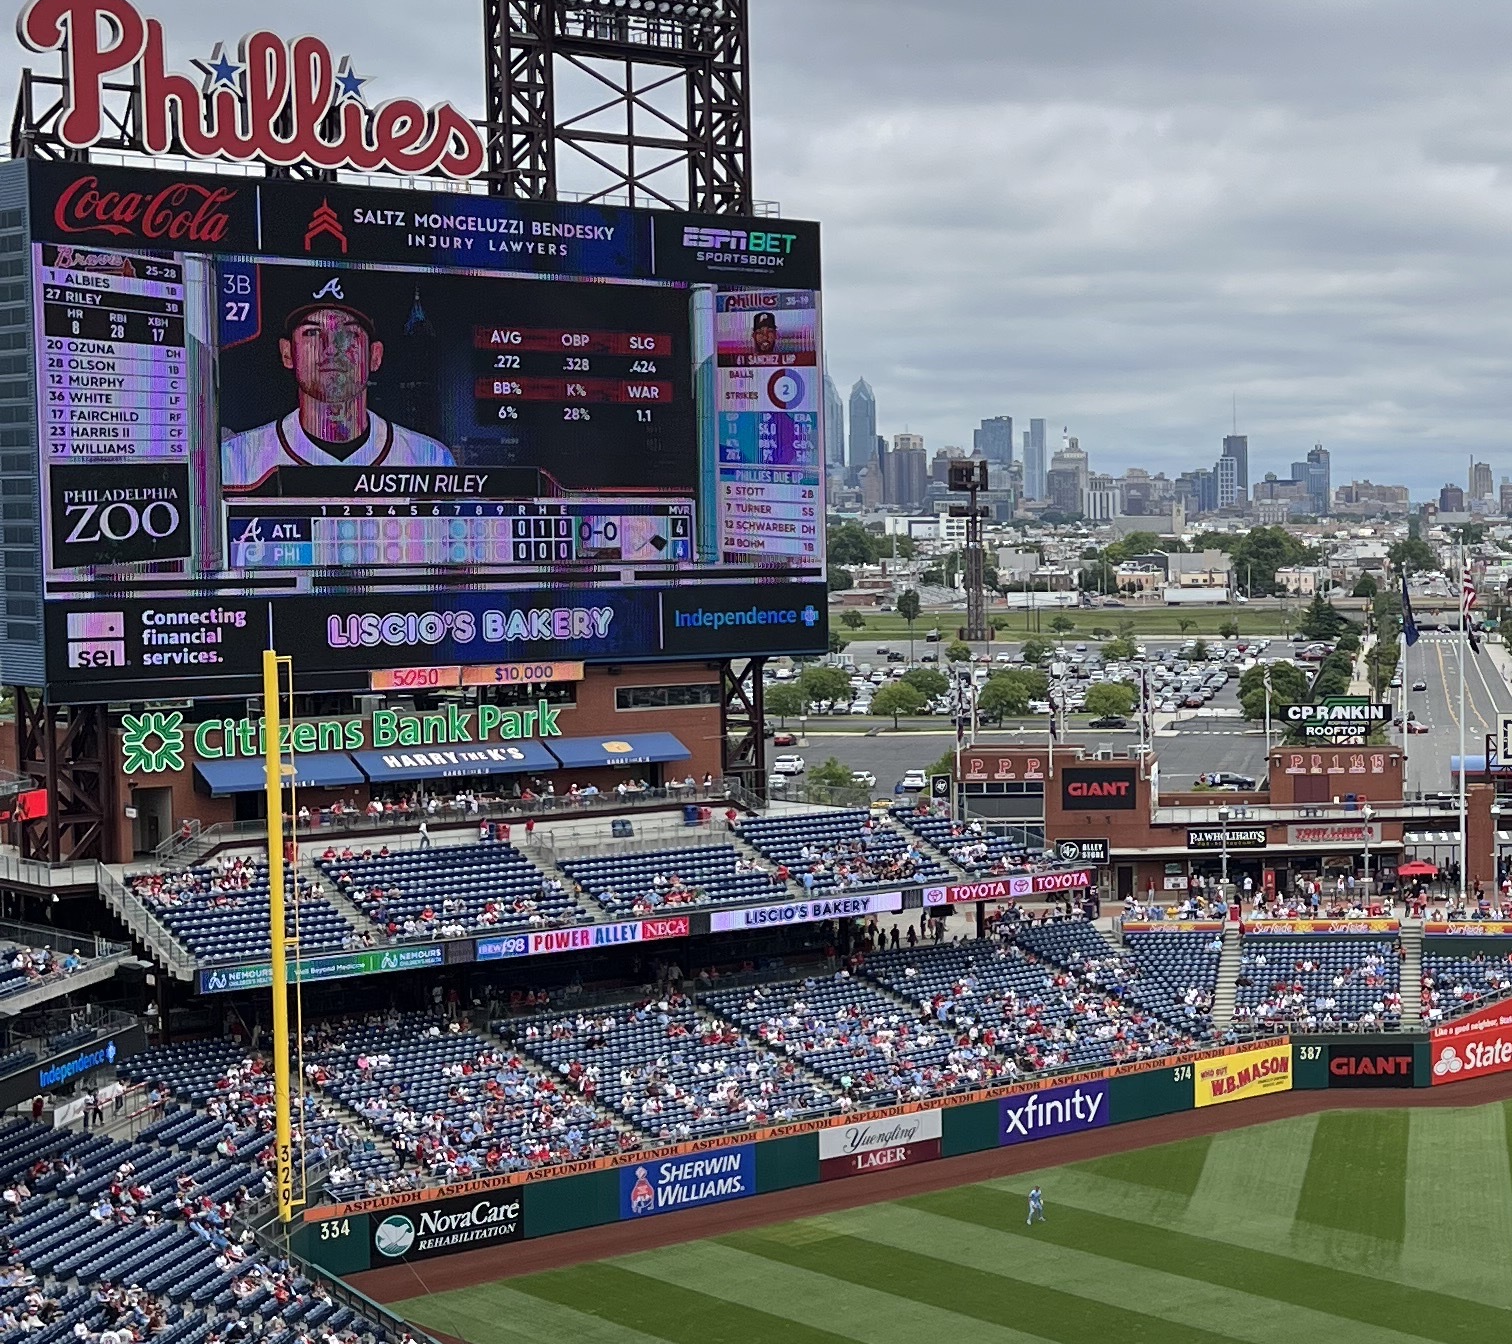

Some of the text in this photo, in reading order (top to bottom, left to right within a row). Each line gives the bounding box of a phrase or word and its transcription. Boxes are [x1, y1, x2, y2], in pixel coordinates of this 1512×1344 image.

[353, 209, 615, 241] SALTZ MONGELUZZI BENDESKY
[408, 233, 568, 256] INJURY LAWYERS
[697, 251, 785, 266] SPORTSBOOK
[146, 265, 177, 279] 25-28
[64, 273, 110, 290] ALBIES
[223, 274, 251, 294] 3B
[45, 288, 102, 305] 27 RILEY
[109, 313, 127, 324] RBI
[225, 303, 250, 321] 27
[47, 339, 115, 355] 20 OZUNA
[490, 330, 655, 350] AVG OBP SLG
[68, 358, 116, 372] OLSON
[493, 355, 656, 374] .272 .328 .424
[50, 374, 124, 389] 12 MURPHY
[493, 382, 660, 399] BB% K% WAR
[49, 391, 112, 404] 36 WHITE
[725, 391, 758, 400] STRIKES
[70, 410, 139, 423] FAIRCHILD
[498, 406, 591, 421] 6% 28%
[50, 426, 119, 438] 23 HARRIS
[51, 443, 135, 455] 37 WILLIAMS
[354, 474, 488, 493] AUSTIN RILEY
[735, 487, 765, 497] STOTT
[64, 487, 178, 503] PHILADELPHIA
[735, 504, 772, 514] TURNER
[64, 501, 179, 544] ZOO
[272, 524, 301, 538] ATL
[735, 520, 796, 533] SCHWARBER
[735, 538, 765, 549] BOHM
[274, 547, 300, 561] PHI
[142, 608, 247, 627] Connecting
[675, 607, 797, 630] Independence
[142, 627, 222, 645] financial
[328, 607, 613, 648] LISCIO'S BAKERY
[143, 648, 224, 666] services.
[1287, 706, 1384, 720] CP RANKIN
[372, 704, 472, 747] Bank
[478, 699, 563, 740] Park
[1305, 726, 1366, 736] ROOFTOP
[382, 747, 525, 768] HARRY THE K'S
[1068, 782, 1129, 797] GIANT
[951, 872, 1089, 901] TOYOTA TOYOTA
[745, 897, 870, 925] LISCIO'S BAKERY
[534, 924, 638, 952] POWER ALLEY
[644, 920, 687, 939] NECA
[400, 948, 441, 961] NEMOURS
[1300, 1047, 1321, 1060] 387
[39, 1049, 104, 1088] Independence
[1173, 1066, 1191, 1082] 374
[1330, 1056, 1412, 1076] GIANT
[1006, 1088, 1103, 1135] xfinity
[343, 1038, 1288, 1214] ASPLUNDH ASPLUNDH ASPLUNDH ASPLUNDH ASPLUNDH ASPLUNDH ASPLUNDH ASPLUNDH ASPLUNDH ASPLUNDH ASPLUNDH ASPLUNDH ASPLUNDH
[843, 1118, 920, 1152] Yuengling
[856, 1147, 907, 1170] LAGER
[281, 1145, 291, 1207] 329
[658, 1153, 741, 1185] SHERWIN
[417, 1200, 519, 1236] NovaCare
[320, 1219, 350, 1241] 334
[418, 1222, 516, 1251] REHABILITATION
